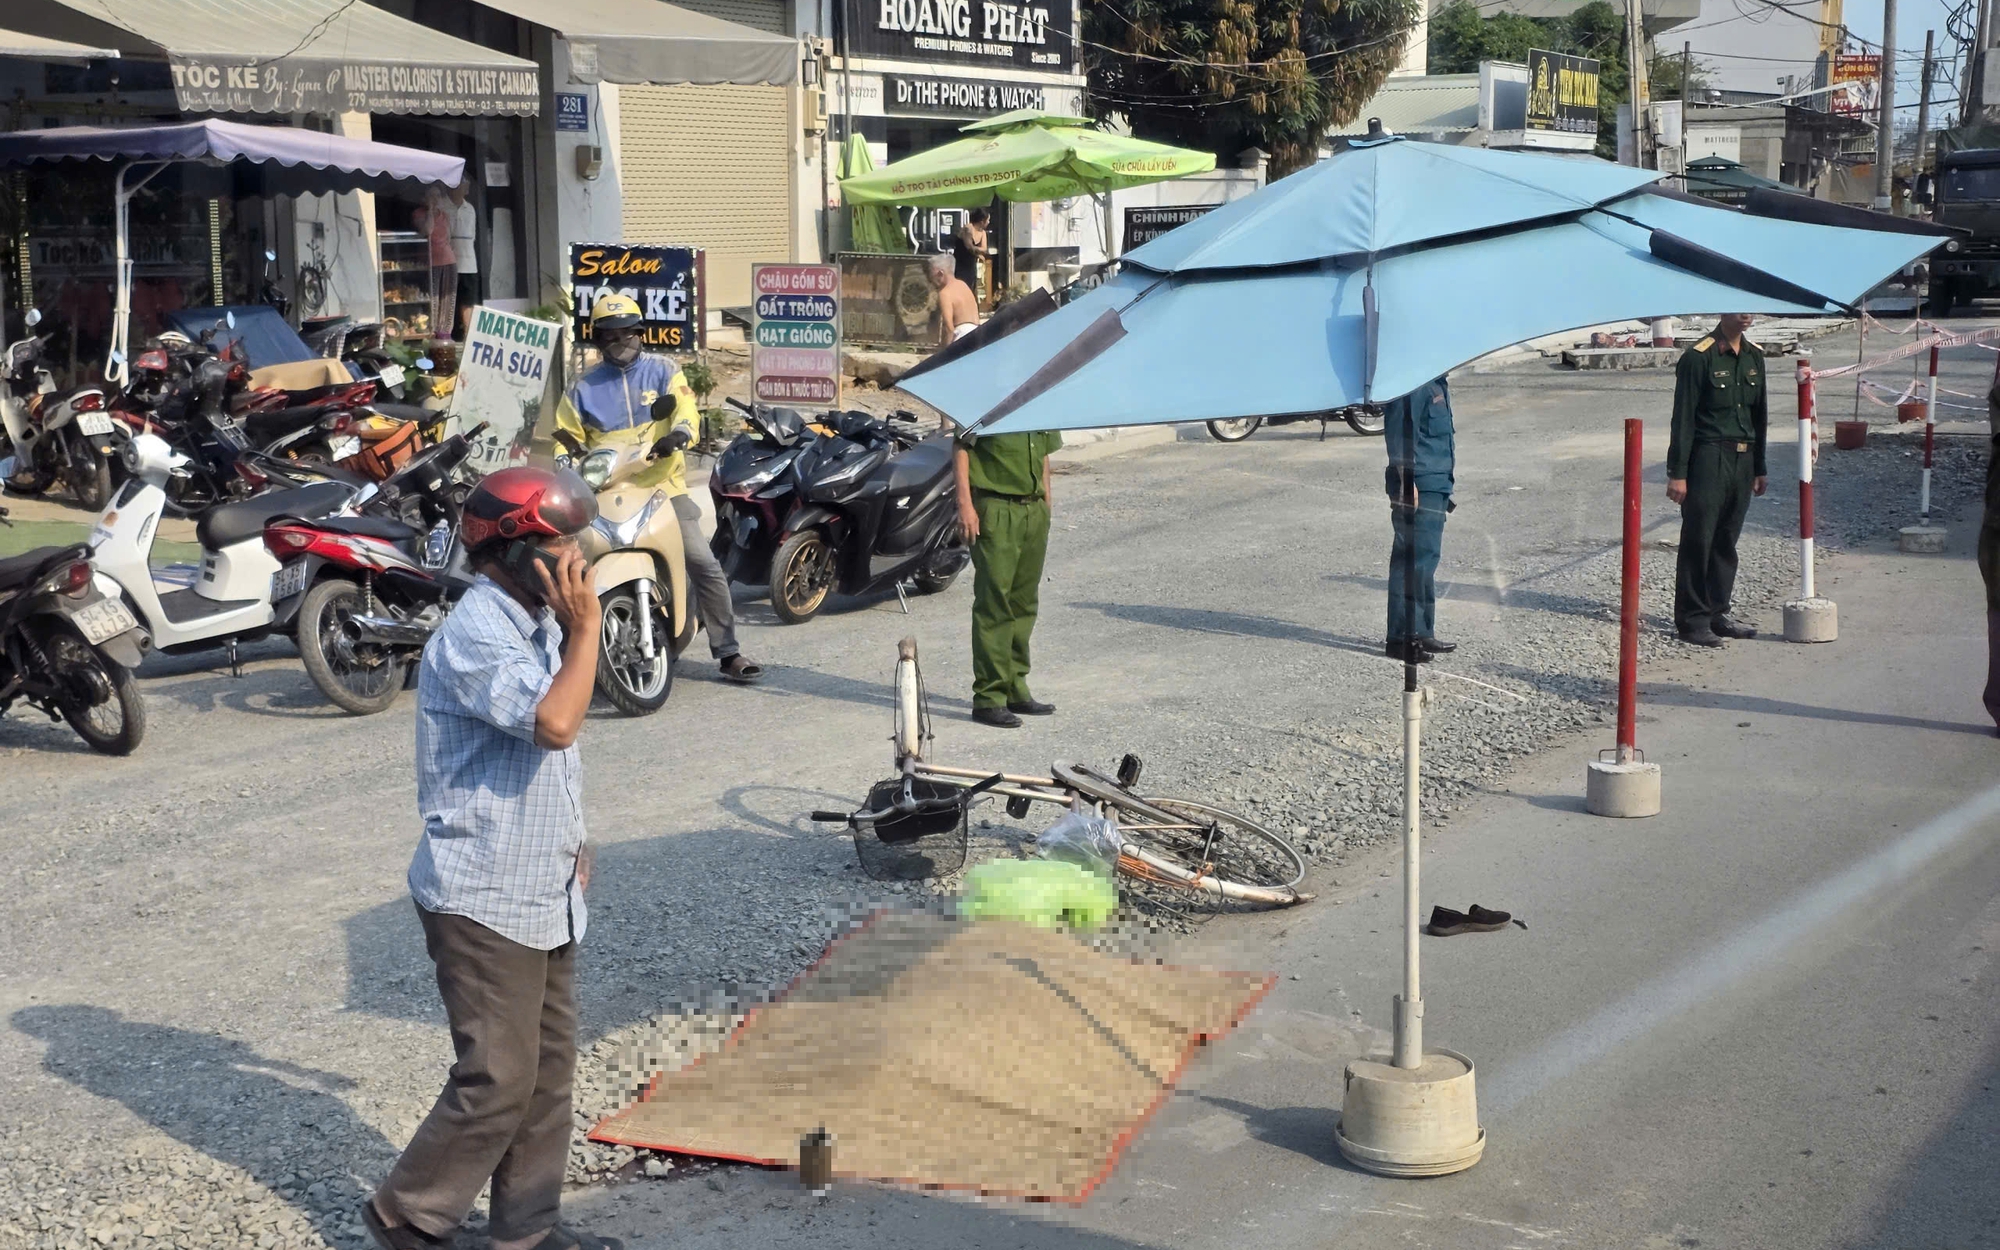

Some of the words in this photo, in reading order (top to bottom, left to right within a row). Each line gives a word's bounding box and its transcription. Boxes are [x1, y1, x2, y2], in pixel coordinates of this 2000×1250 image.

[914, 36, 948, 52] PREMIUM
[949, 40, 976, 55] PHONES
[977, 43, 983, 54] &
[984, 43, 1013, 57] WATCHES
[1031, 52, 1047, 63] Since
[264, 66, 289, 108] By:
[344, 65, 391, 92] MASTER
[391, 67, 443, 94] COLORIST
[445, 69, 454, 93] &
[456, 69, 497, 95] STYLIST
[499, 72, 540, 96] CANADA
[349, 92, 366, 107] 279
[562, 96, 582, 113] 281
[914, 82, 938, 104] THE
[941, 84, 984, 107] PHONE
[988, 86, 998, 108] &
[1000, 87, 1042, 111] WATCH
[1132, 210, 1178, 224] CHÍNH
[1133, 230, 1144, 242] ÉP
[577, 251, 661, 276] Salon
[759, 271, 789, 293] CHẬU
[791, 269, 815, 290] GỐM
[818, 271, 833, 290] SỨ
[645, 273, 687, 321] KỂ
[759, 296, 786, 316] ĐẤT
[788, 296, 833, 318] TRỒNG
[476, 310, 550, 350] MATCHA
[760, 328, 787, 347] HẠT
[790, 323, 833, 344] GIỐNG
[471, 341, 503, 371] TRÀ
[508, 350, 543, 381] SỮA
